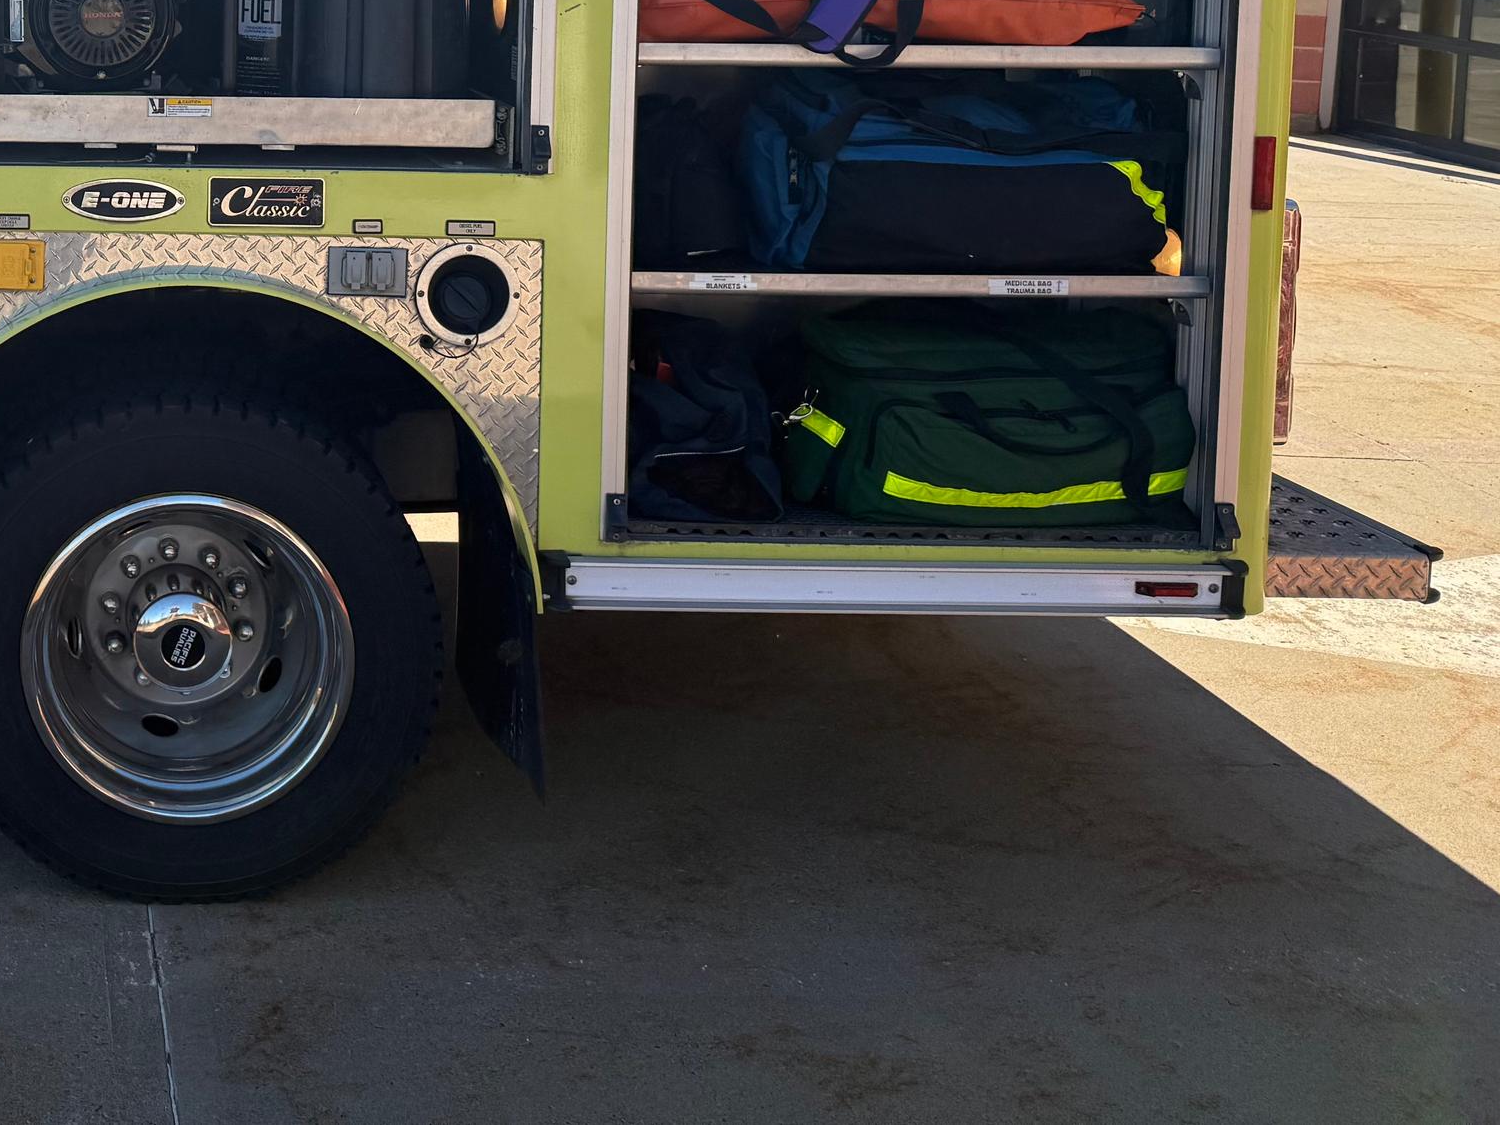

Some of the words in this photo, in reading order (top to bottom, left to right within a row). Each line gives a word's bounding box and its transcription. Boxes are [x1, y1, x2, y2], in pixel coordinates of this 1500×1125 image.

[84, 11, 123, 19] HONDA
[81, 191, 167, 210] E-ONE
[220, 185, 311, 218] Classic
[264, 185, 313, 194] FIRE
[170, 627, 190, 663] DUALIES
[177, 629, 197, 666] PACIFIC
